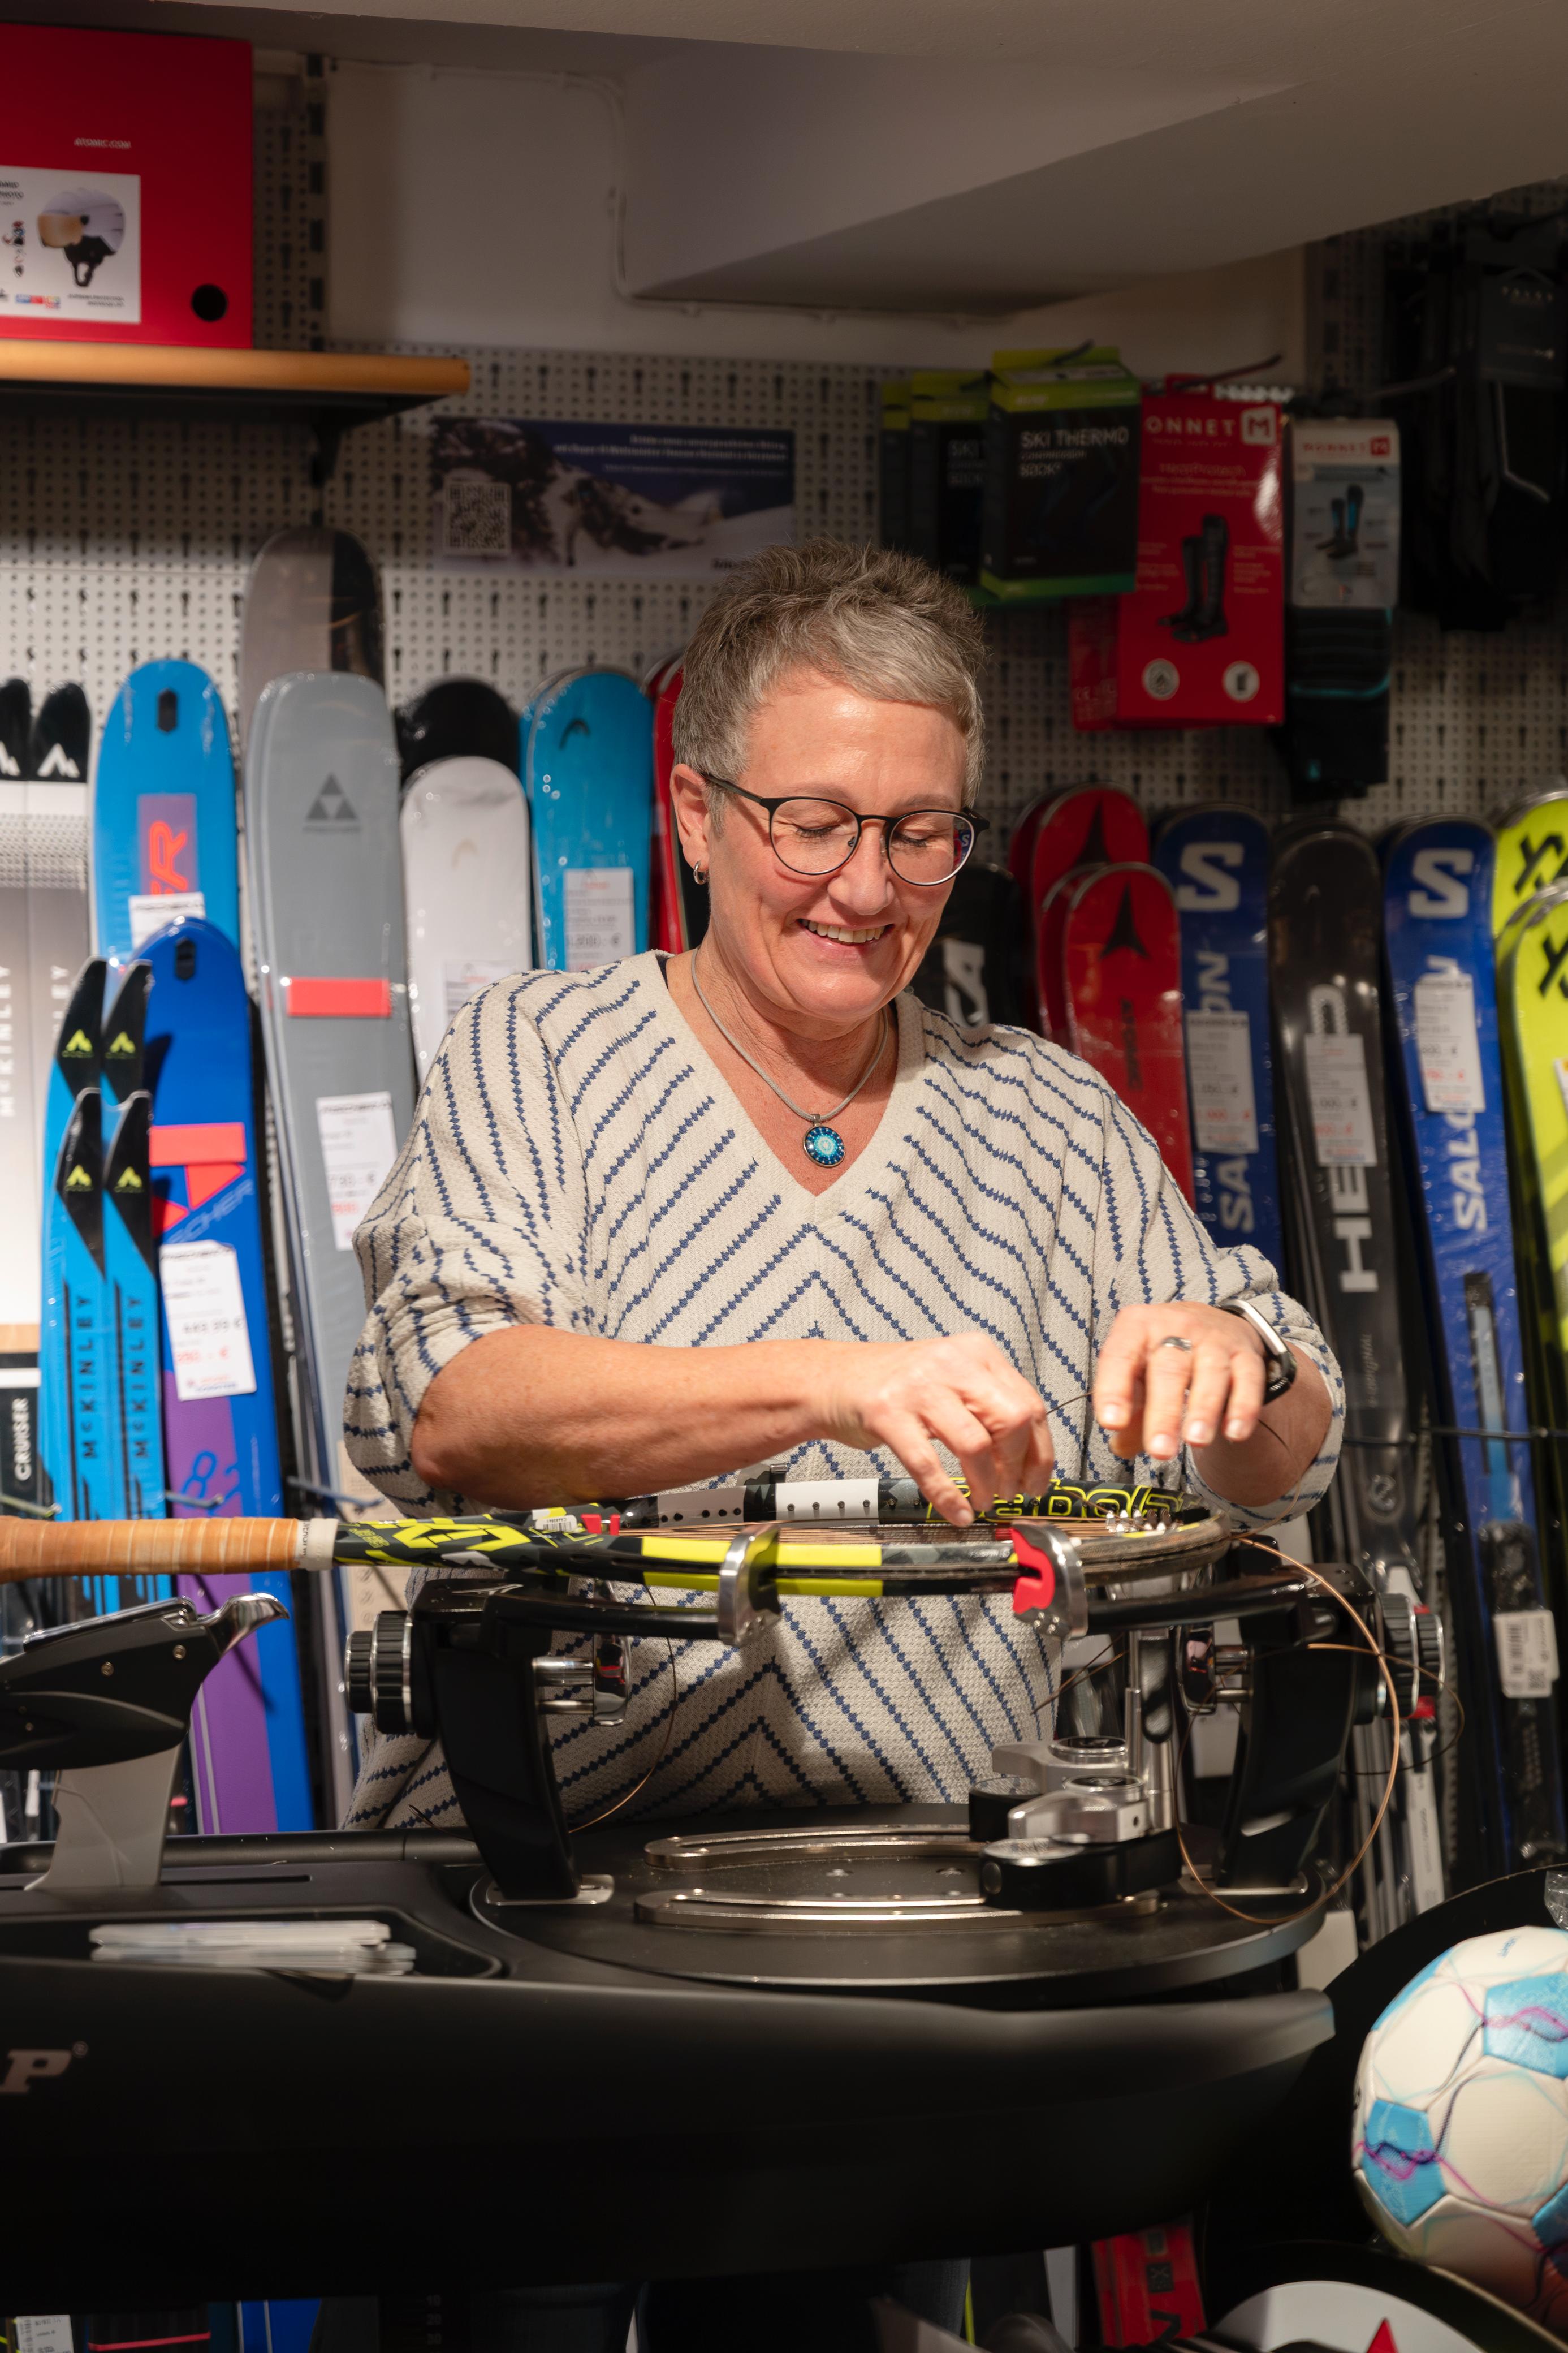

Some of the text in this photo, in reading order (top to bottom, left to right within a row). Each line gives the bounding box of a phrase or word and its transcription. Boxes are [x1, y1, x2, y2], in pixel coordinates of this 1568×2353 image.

[1020, 430, 1051, 449] SKI
[1054, 426, 1130, 447] THERMO
[1176, 842, 1244, 912] S
[1408, 848, 1473, 918] S
[12, 1397, 32, 1482] CRUISER
